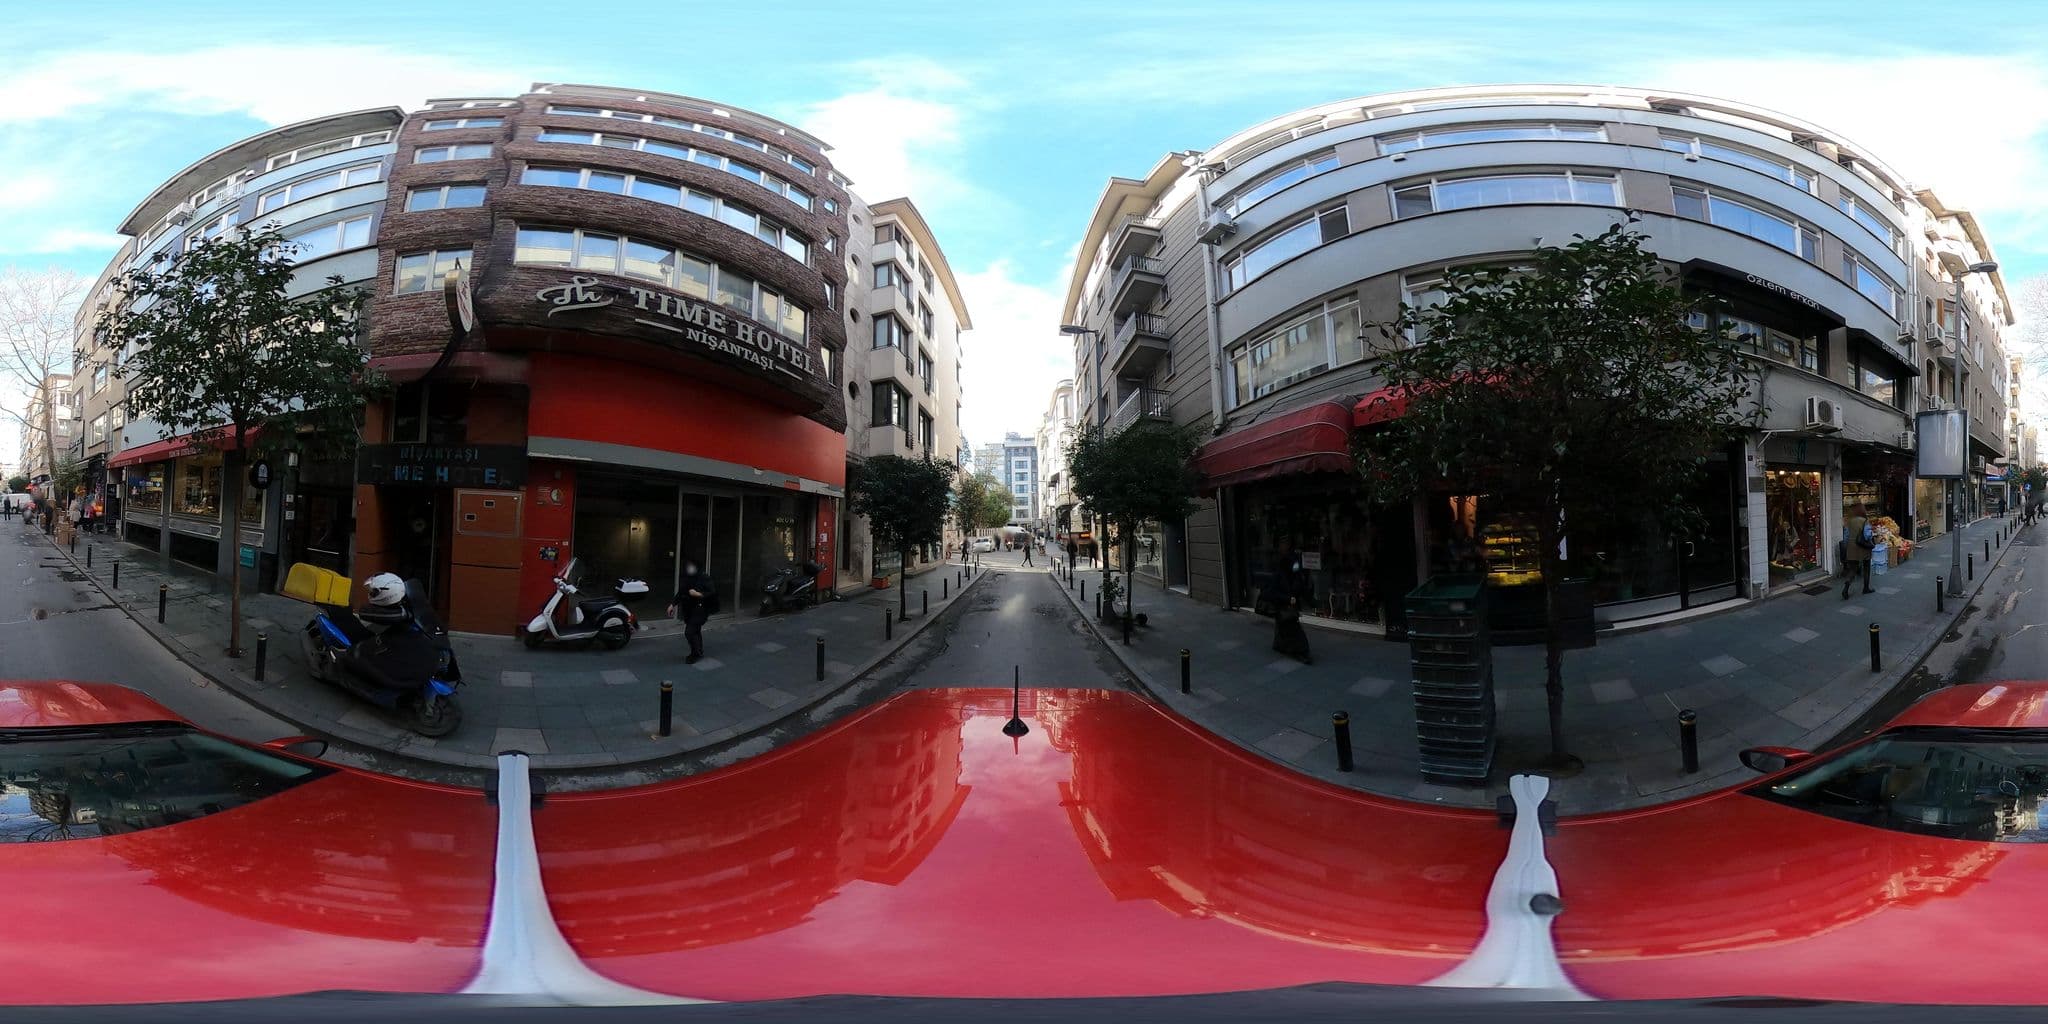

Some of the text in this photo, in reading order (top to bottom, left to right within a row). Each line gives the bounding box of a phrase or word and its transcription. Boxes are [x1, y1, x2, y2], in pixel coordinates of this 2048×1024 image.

[629, 286, 815, 375] TIME HOTEL
[686, 328, 775, 371] NİŞANTAŞI
